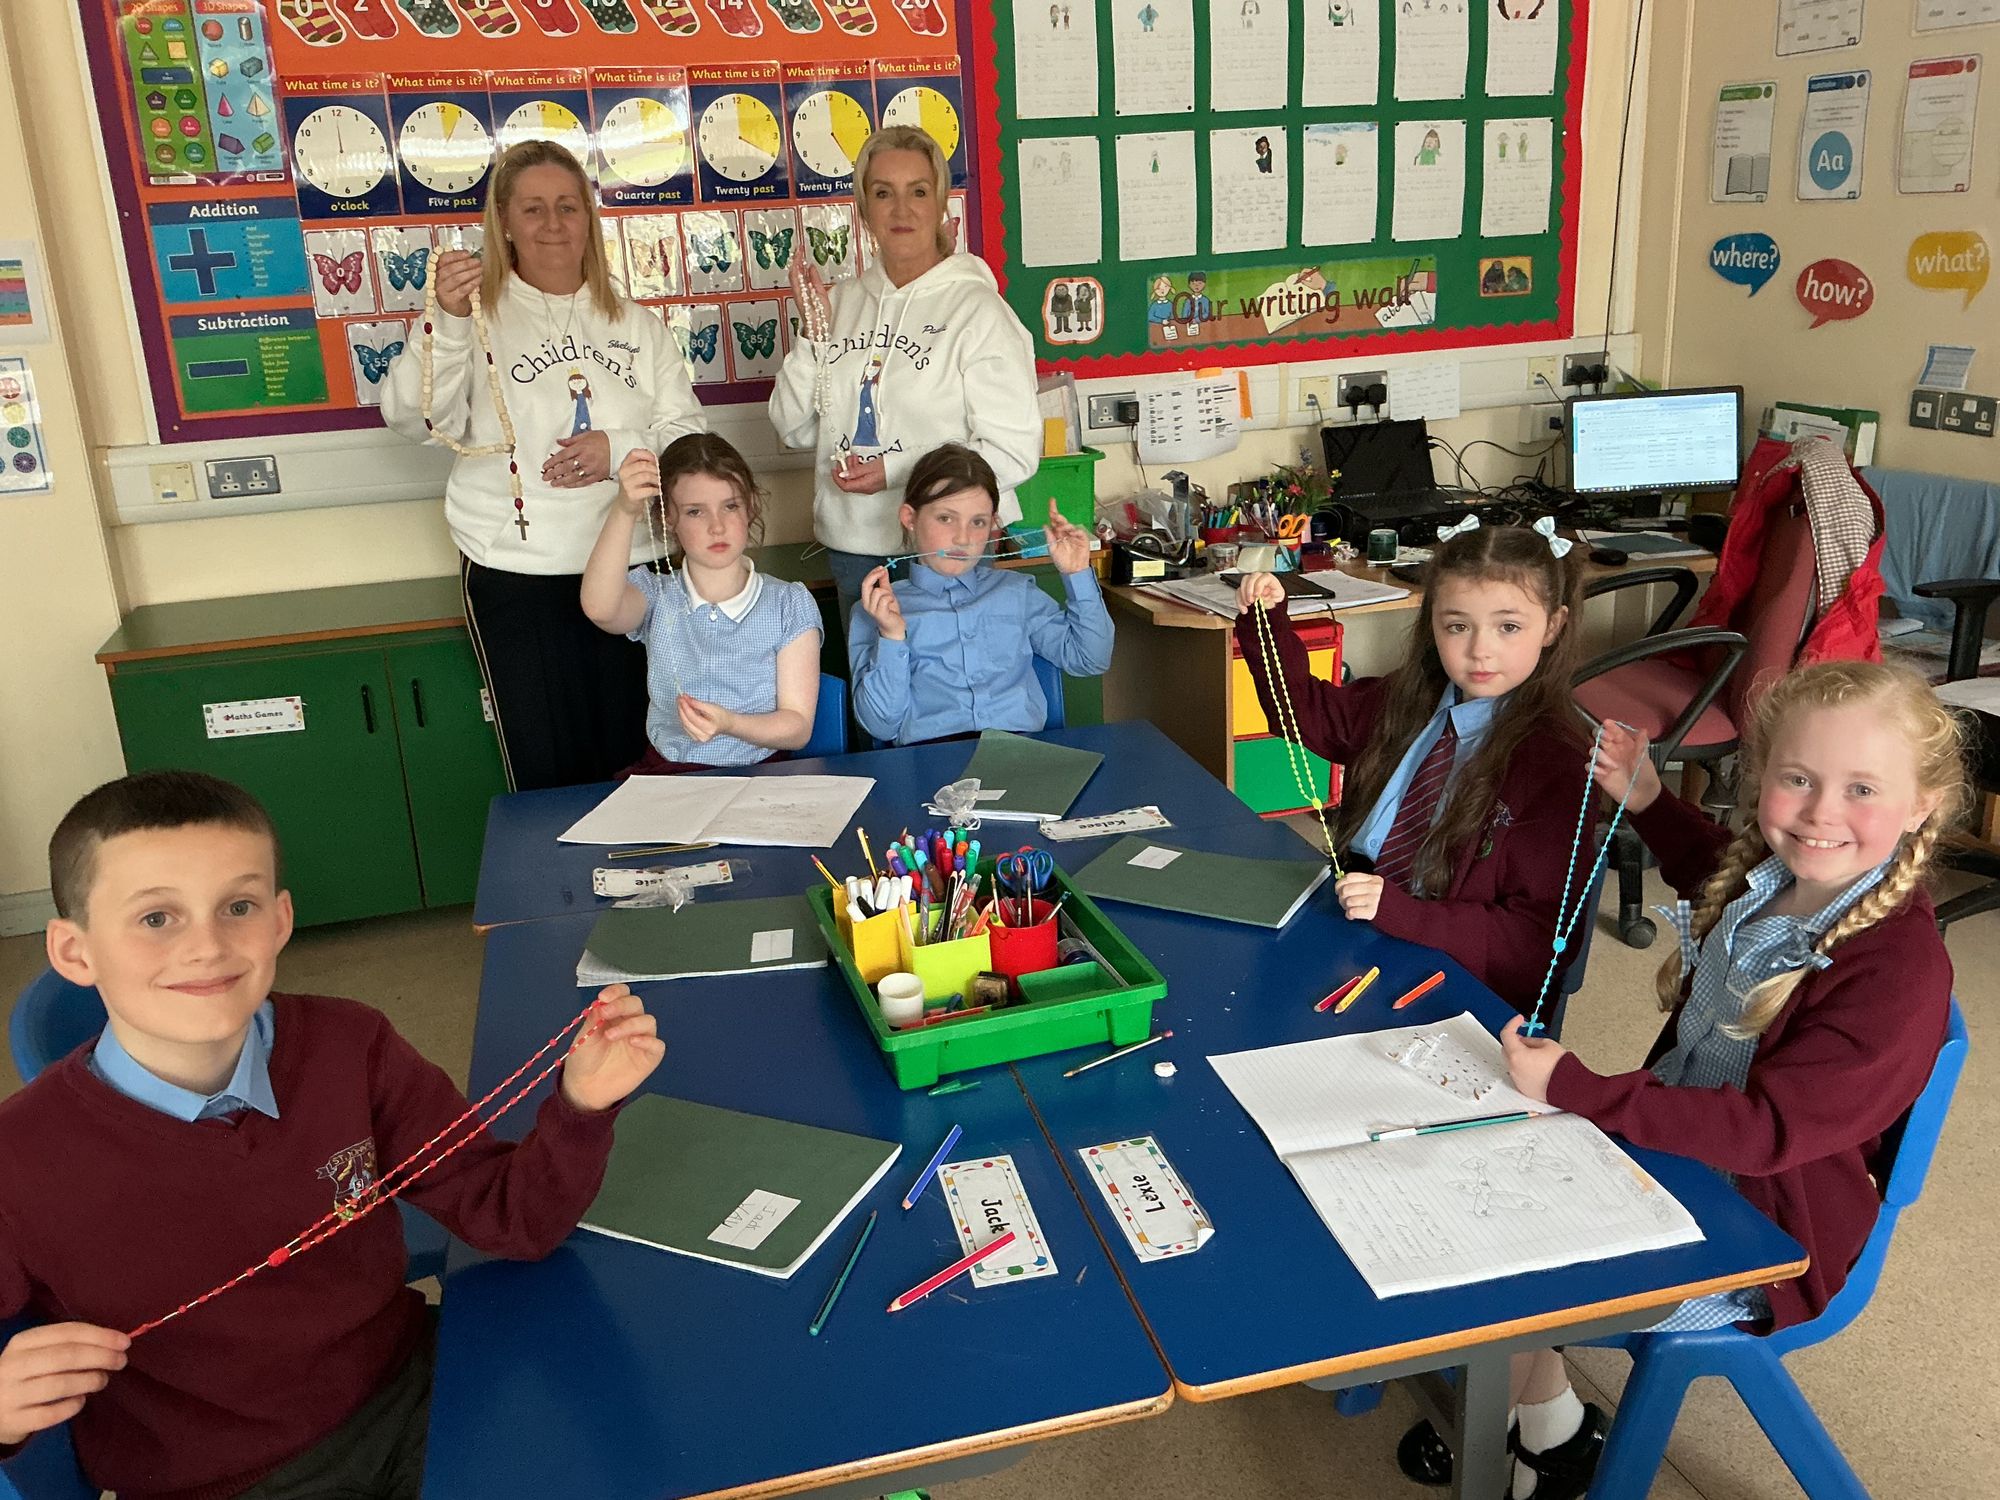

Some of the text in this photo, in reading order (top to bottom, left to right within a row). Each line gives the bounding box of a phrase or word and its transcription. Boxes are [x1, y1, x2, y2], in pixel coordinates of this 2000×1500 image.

[787, 65, 867, 77] What time is it?
[878, 61, 957, 73] What time is it?
[595, 72, 681, 82] What time is it?
[692, 68, 775, 79] What time is it?
[286, 79, 380, 90] What time is it?
[392, 76, 483, 87] What time is it?
[494, 74, 582, 86] What time is it?
[732, 96, 741, 104] 12
[715, 102, 723, 110] 11
[332, 109, 342, 117] 12
[301, 129, 310, 137] 10
[1817, 150, 1844, 172] Aa
[715, 184, 774, 196] Twenty past
[800, 180, 853, 193] Twenty Five
[616, 191, 681, 201] Quarter past
[331, 201, 369, 212] o'clock
[429, 198, 477, 208] Five past
[190, 204, 259, 217] Addition
[1713, 243, 1777, 269] where?
[1916, 243, 1984, 274] what?
[337, 268, 344, 276] 0
[403, 264, 410, 273] 5
[1804, 270, 1868, 308] how?
[1172, 275, 1412, 325] Our writing wall
[198, 315, 289, 330] Subtraction
[691, 339, 704, 348] 80
[750, 334, 763, 344] 85
[375, 358, 388, 367] 55
[511, 336, 637, 388] Children's
[1133, 1174, 1166, 1213] Lexie
[981, 1199, 1010, 1234] Jack
